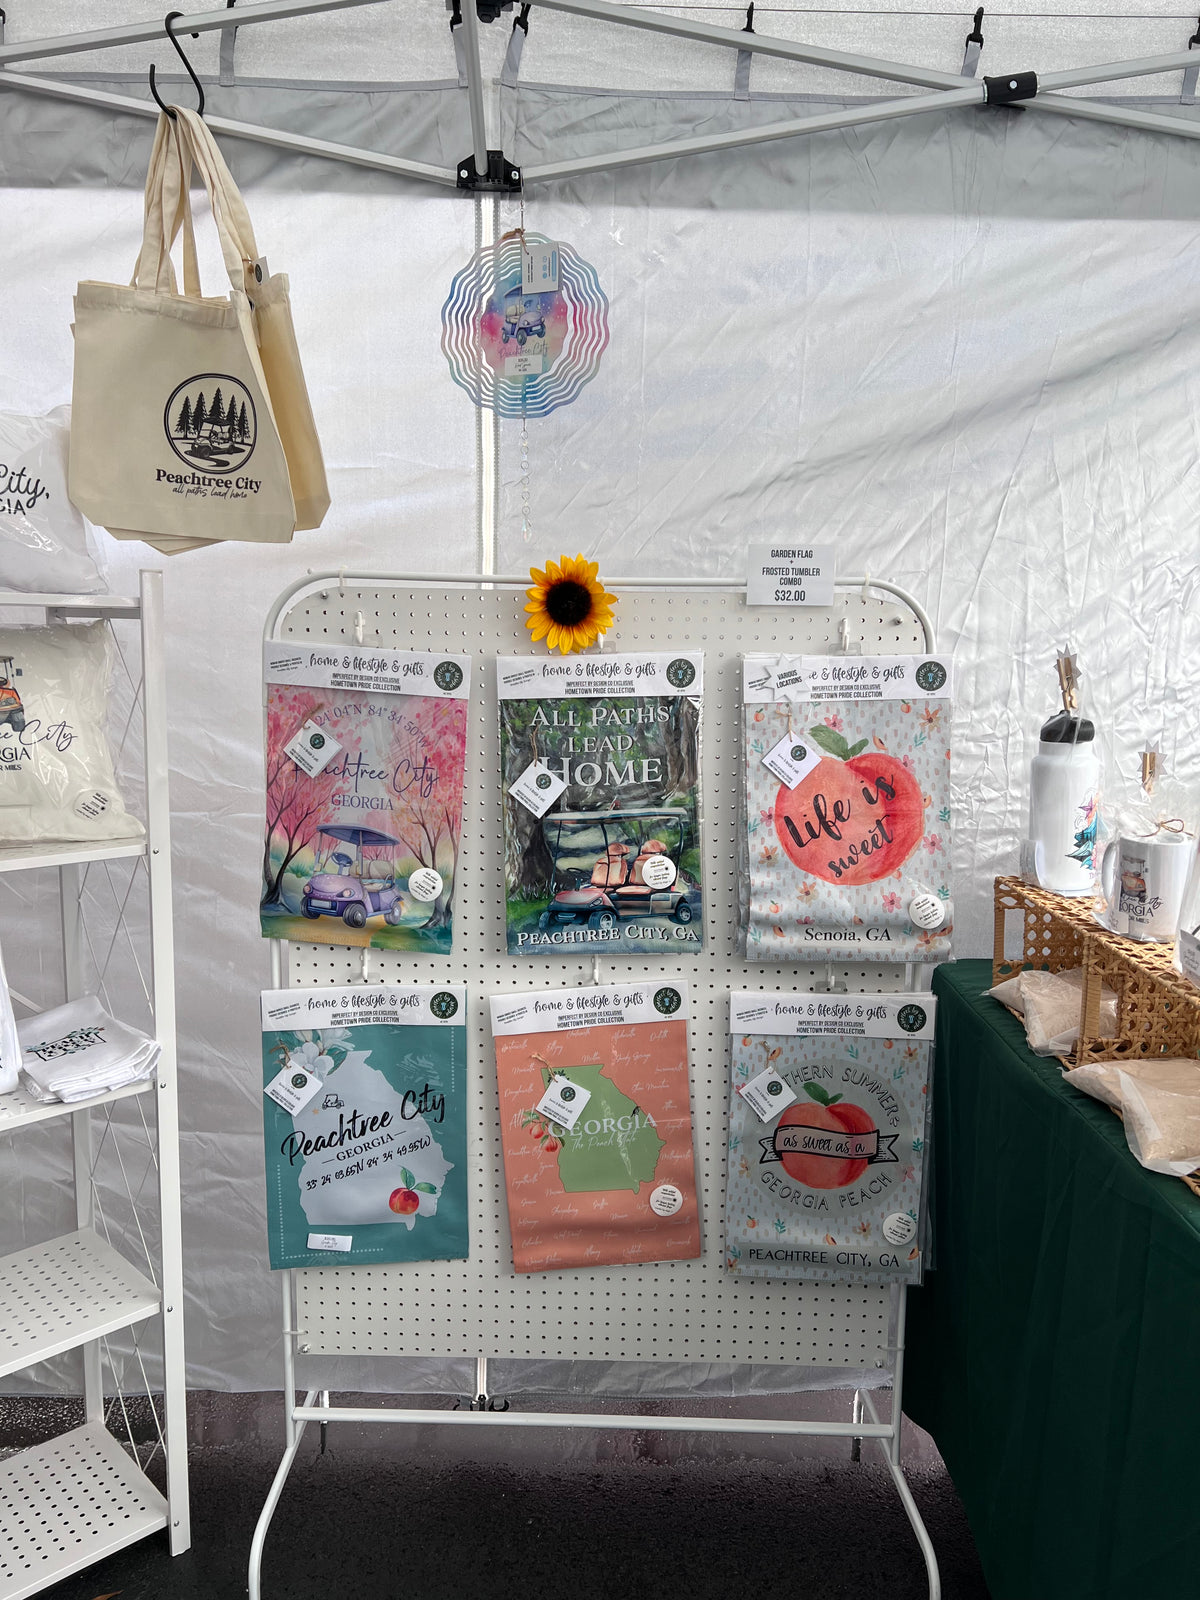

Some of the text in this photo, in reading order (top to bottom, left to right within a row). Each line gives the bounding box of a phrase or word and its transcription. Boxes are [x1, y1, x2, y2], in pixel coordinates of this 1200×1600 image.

[156, 469, 261, 493] Peachtree City
[771, 550, 813, 558] GARDEN FLAG
[762, 567, 820, 576] FROSTED TUMBLER
[775, 589, 805, 601] $32.00
[310, 653, 339, 667] home
[343, 656, 351, 669] &
[353, 657, 389, 674] lifestyle
[391, 660, 399, 673] &
[403, 662, 424, 676] gifts
[542, 662, 656, 678] home & lifestyle & gifts
[821, 666, 906, 682] & lifestyle & gifts
[776, 676, 802, 689] LOCATIONS
[777, 670, 797, 680] VARIOUS
[373, 683, 400, 691] COLLECTION
[530, 705, 671, 727] ALL PATHS
[19, 719, 78, 752] City
[568, 734, 636, 753] LEAD
[392, 755, 440, 798] City
[538, 756, 663, 787] HOME
[331, 794, 394, 811] GEORGIA
[784, 774, 896, 848] Life is
[828, 814, 894, 878] sweet
[517, 924, 700, 947] PEACHTREE CITY, GA
[804, 928, 892, 942] Senoia, GA
[307, 993, 420, 1011] home & lifestyle & gifts
[534, 992, 643, 1014] home & lifestyle & gifts
[775, 1003, 804, 1016] home
[807, 1004, 815, 1015] &
[818, 1003, 852, 1019] lifestyle
[856, 1005, 864, 1017] &
[867, 1006, 887, 1021] gifts
[557, 1020, 583, 1028] HOMETOWN
[781, 1065, 899, 1127] THERN SUMMERS
[281, 1083, 445, 1166] Peachtree City
[548, 1113, 657, 1137] GEORGIA
[336, 1133, 394, 1162] GEORGIA
[572, 1134, 583, 1152] The
[588, 1131, 613, 1151] Peach
[783, 1134, 865, 1154] as sweet as a
[760, 1170, 892, 1211] GEORGIA PEACH
[749, 1249, 899, 1267] PEACHTREE CITY, GA
